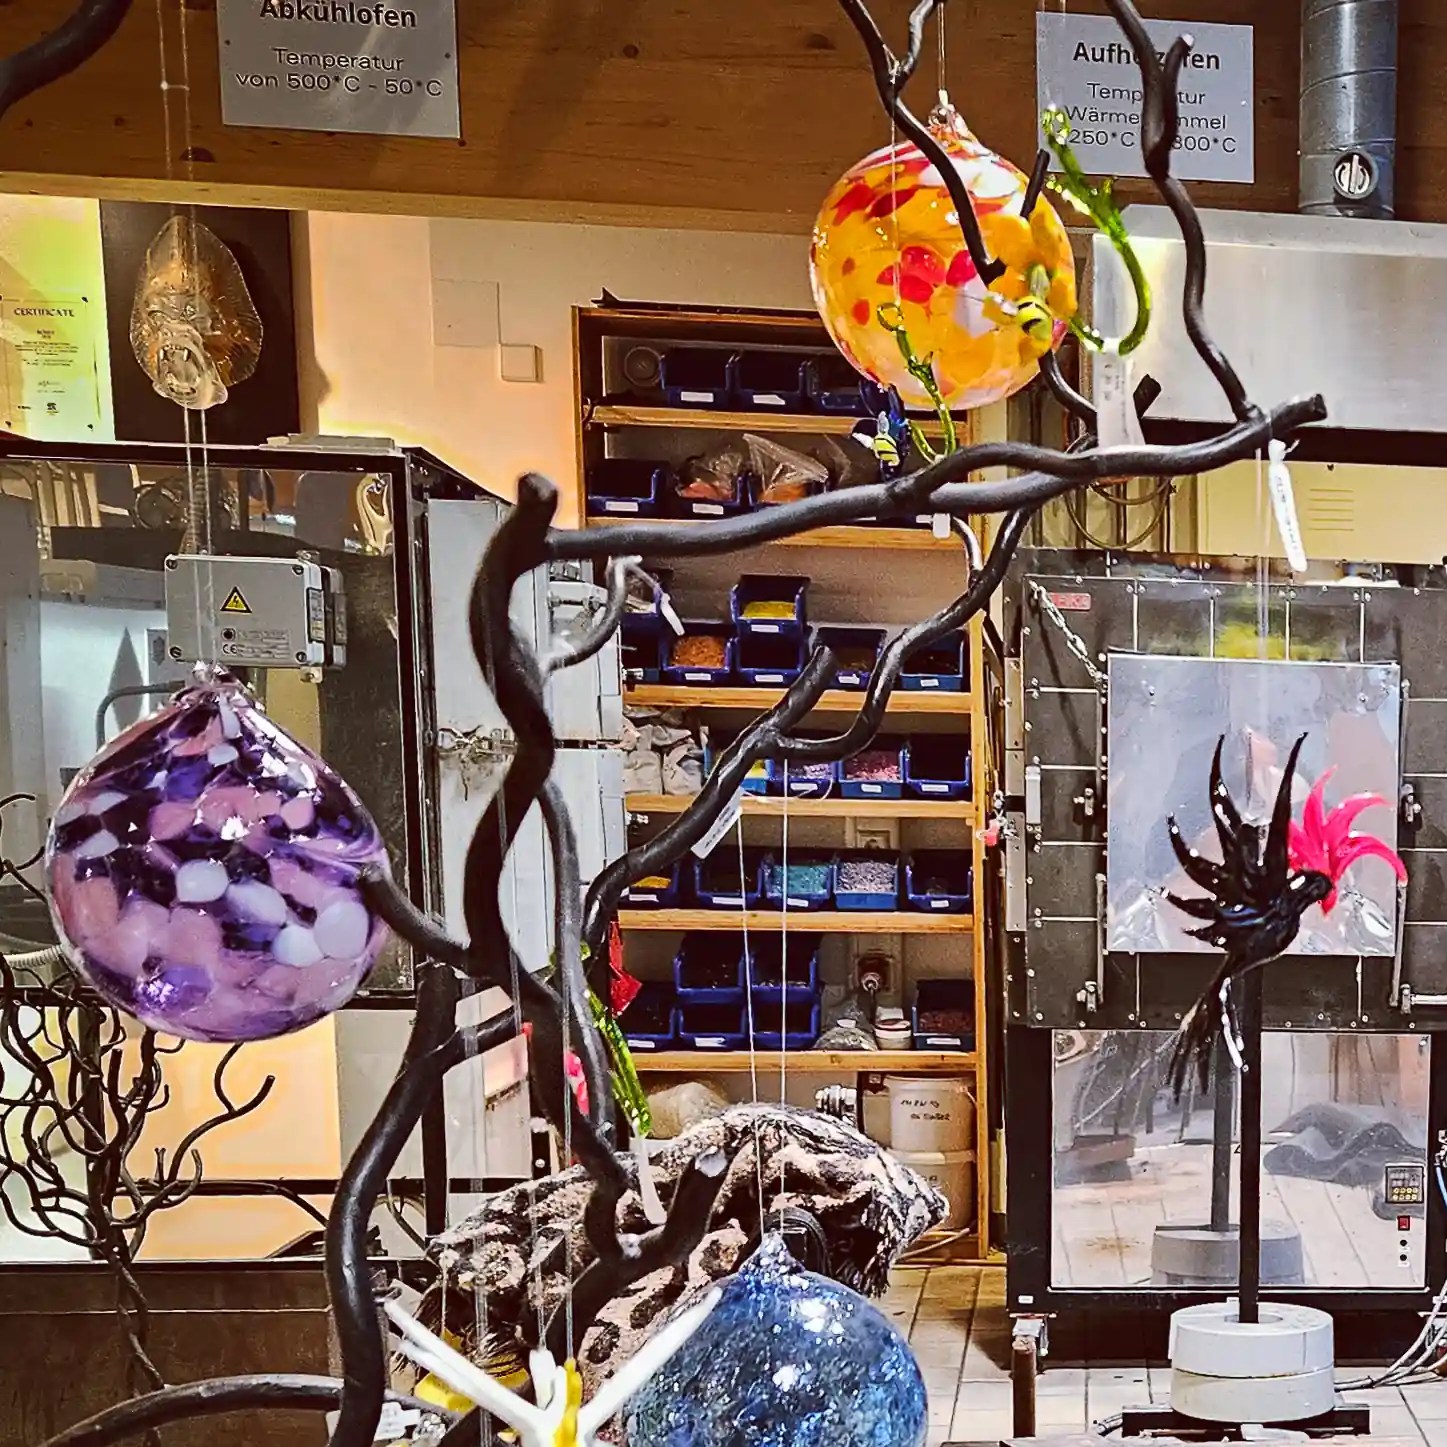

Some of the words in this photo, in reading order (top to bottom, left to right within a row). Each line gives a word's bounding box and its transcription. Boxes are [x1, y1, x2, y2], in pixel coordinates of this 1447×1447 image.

[259, 0, 417, 28] Abkühlofen
[272, 47, 405, 72] Temperatur
[1073, 42, 1220, 70] Aufhzfen
[235, 73, 279, 87] von
[1086, 82, 1206, 105] Temptur
[1064, 105, 1226, 130] Wärmemmel
